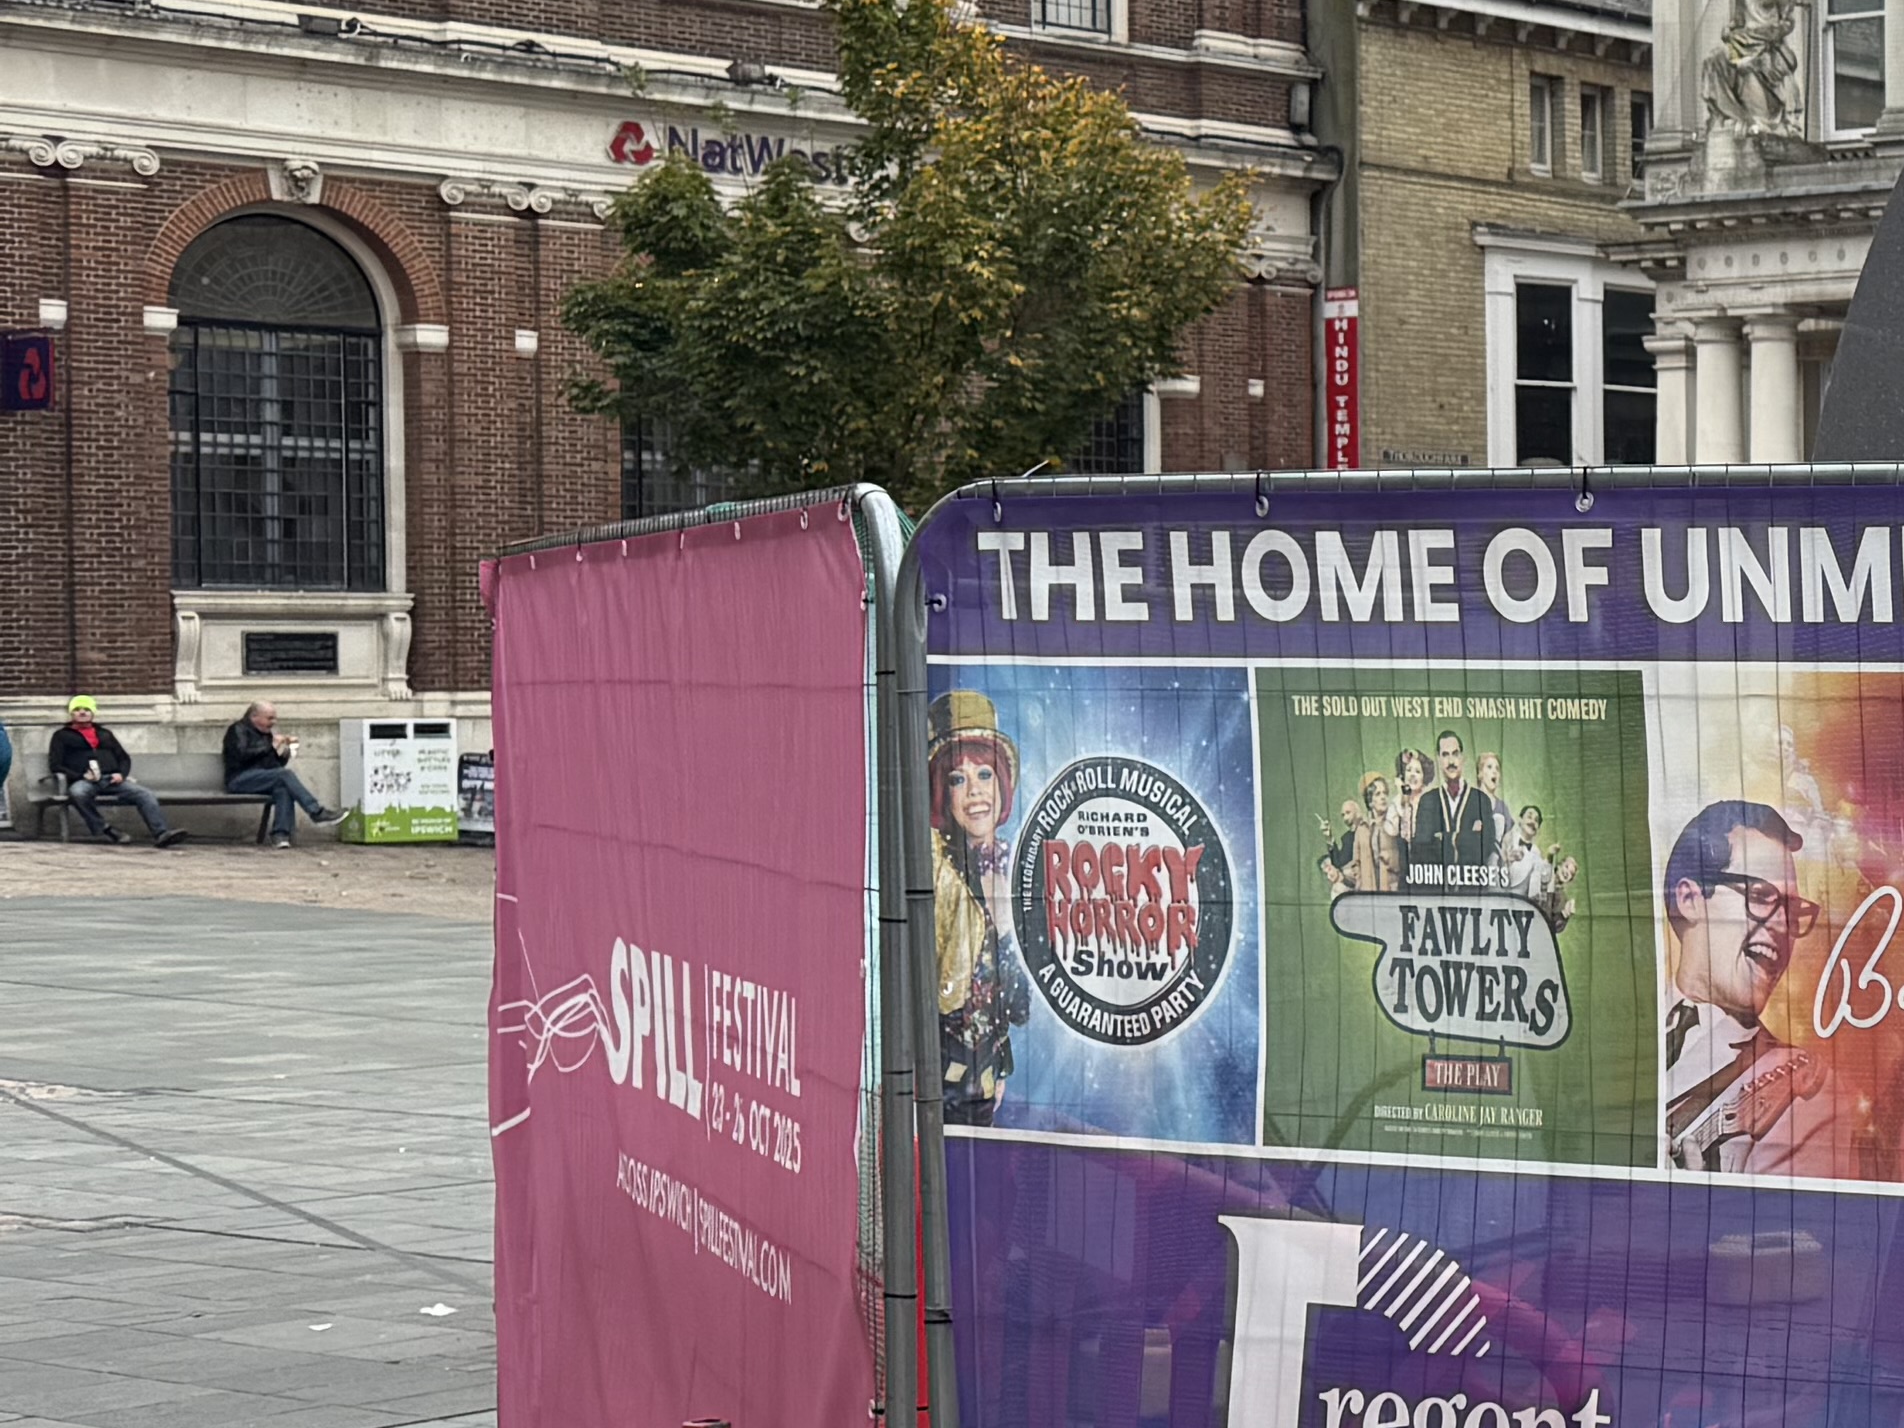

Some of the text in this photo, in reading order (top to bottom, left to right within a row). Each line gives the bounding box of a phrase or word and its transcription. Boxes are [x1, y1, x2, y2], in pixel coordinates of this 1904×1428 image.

[1334, 318, 1349, 386] HINDU
[977, 529, 1149, 622] THE
[1168, 528, 1460, 624] HOME
[1482, 526, 1614, 624] OF
[1291, 695, 1608, 721] THE SOLD OUT WEST END SMASH HIT COMEDY
[1037, 781, 1075, 833] ROCK
[1077, 765, 1118, 792] ROLL
[1119, 767, 1199, 837] MUSICAL
[1077, 810, 1148, 823] RICHARD
[1077, 824, 1151, 837] O'BRIEN'S
[1042, 838, 1206, 905] ROCKY
[1405, 862, 1510, 888] JOHN CLEESE'S
[1045, 898, 1199, 964] HORROR
[1398, 904, 1537, 959] FAWLTY
[1069, 947, 1169, 982] Show
[1388, 956, 1560, 1037] TOWERS
[610, 936, 801, 1120] SPILL FESTIVAL
[1038, 961, 1206, 1039] A GUARANTEED PARTY
[1434, 1061, 1502, 1088] THE PLAY
[749, 1099, 772, 1157] OCT
[773, 1111, 802, 1174] 2025
[1373, 1104, 1413, 1120] DIRECTED
[1424, 1102, 1477, 1124] CAROLINE
[1478, 1104, 1499, 1128] JAY
[1500, 1106, 1544, 1127] RANGER
